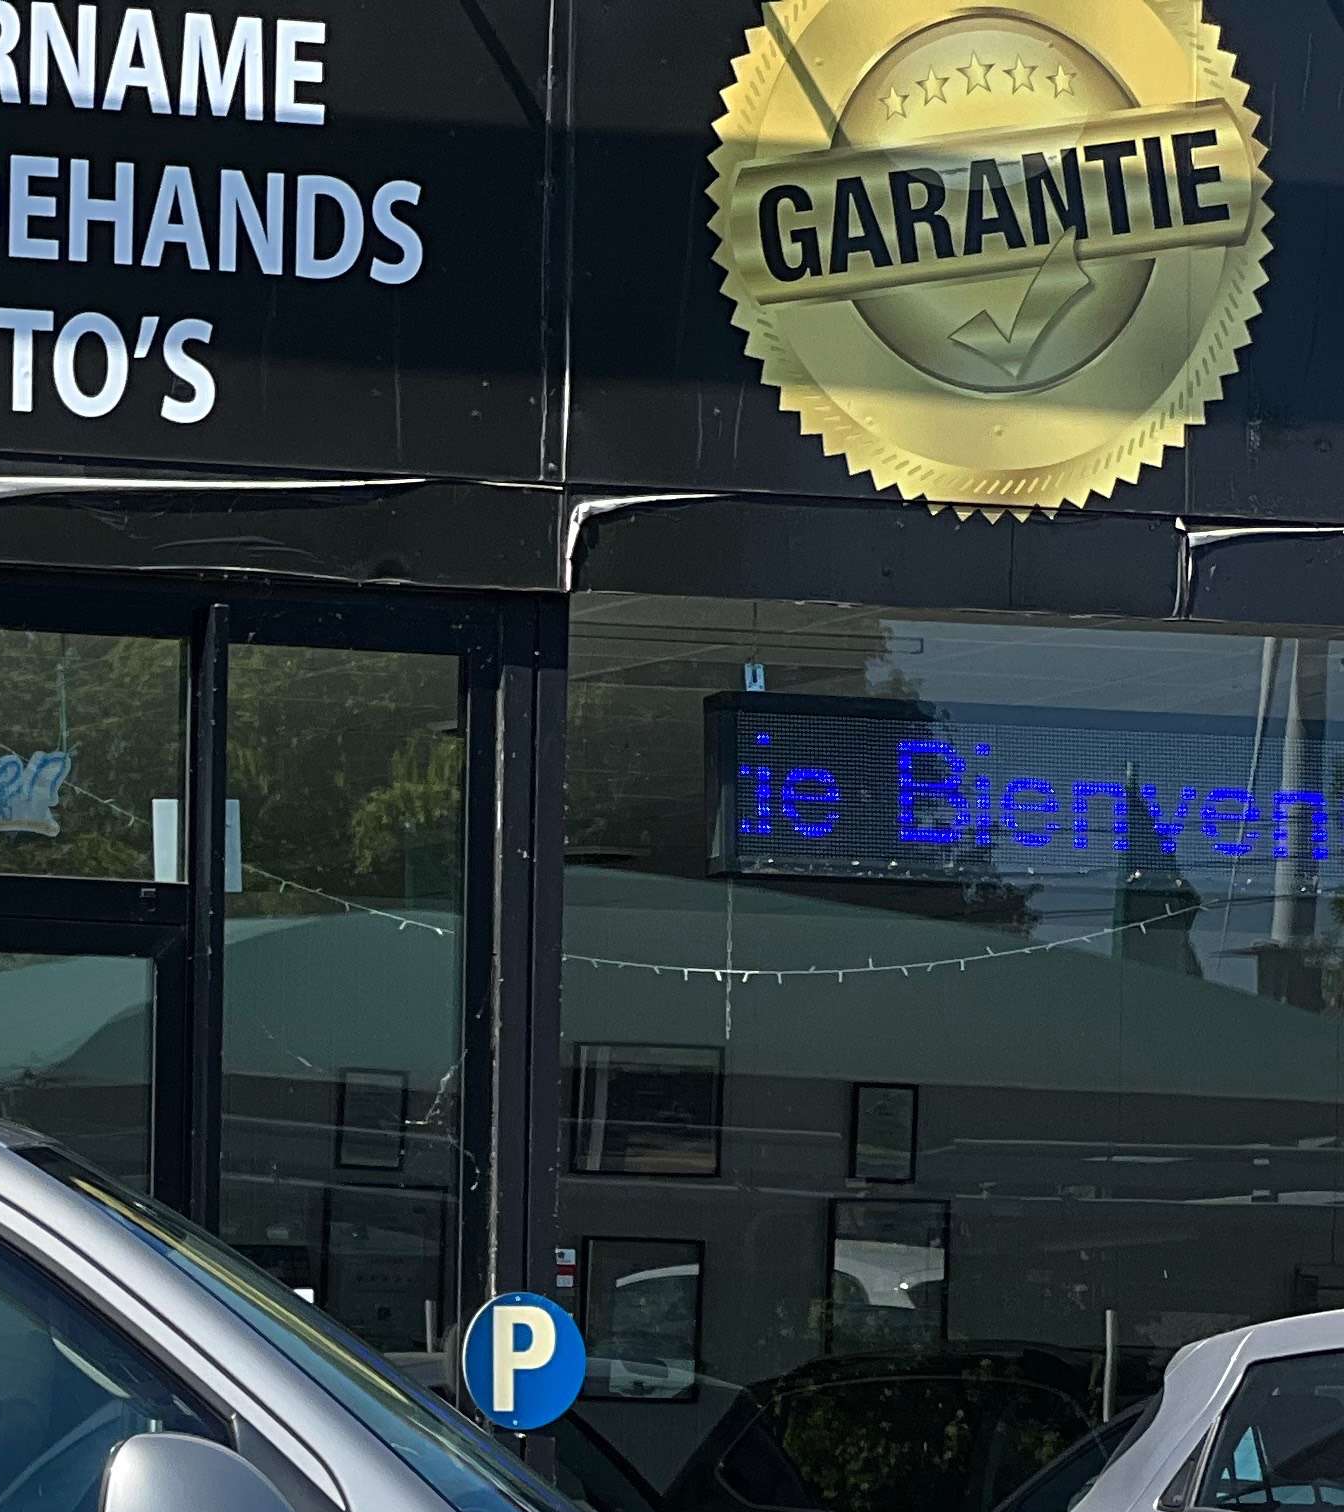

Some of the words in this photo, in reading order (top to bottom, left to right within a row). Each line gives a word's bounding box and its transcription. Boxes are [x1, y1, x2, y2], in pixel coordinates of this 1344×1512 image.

[758, 129, 1230, 283] GARANTIE
[897, 739, 1343, 861] Bienven
[493, 1306, 556, 1412] P
